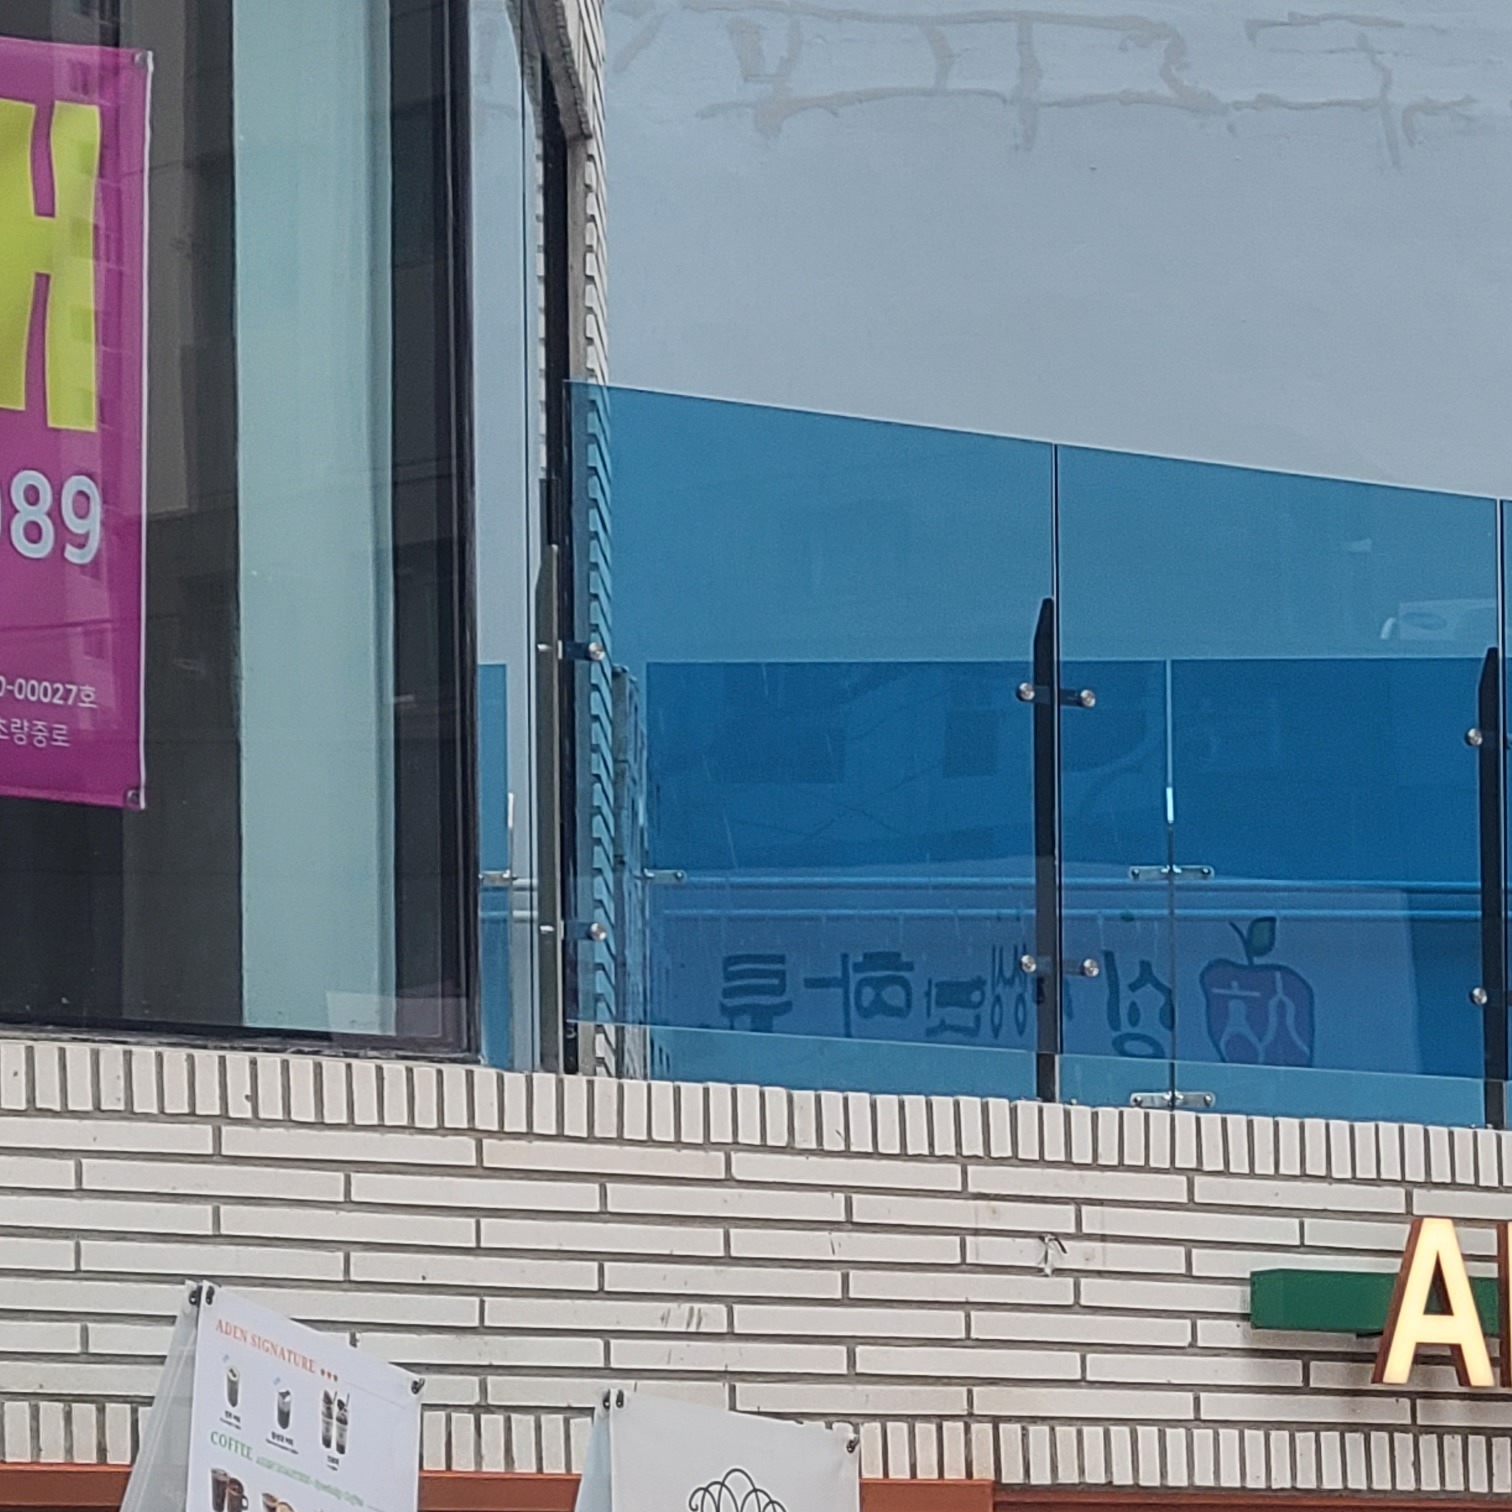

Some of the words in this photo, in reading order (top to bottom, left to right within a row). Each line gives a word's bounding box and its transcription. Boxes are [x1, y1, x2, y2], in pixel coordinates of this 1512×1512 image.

[214, 1318, 249, 1346] ADEN
[250, 1331, 316, 1375] SIGNATURE
[210, 1430, 254, 1462] COFFEE
